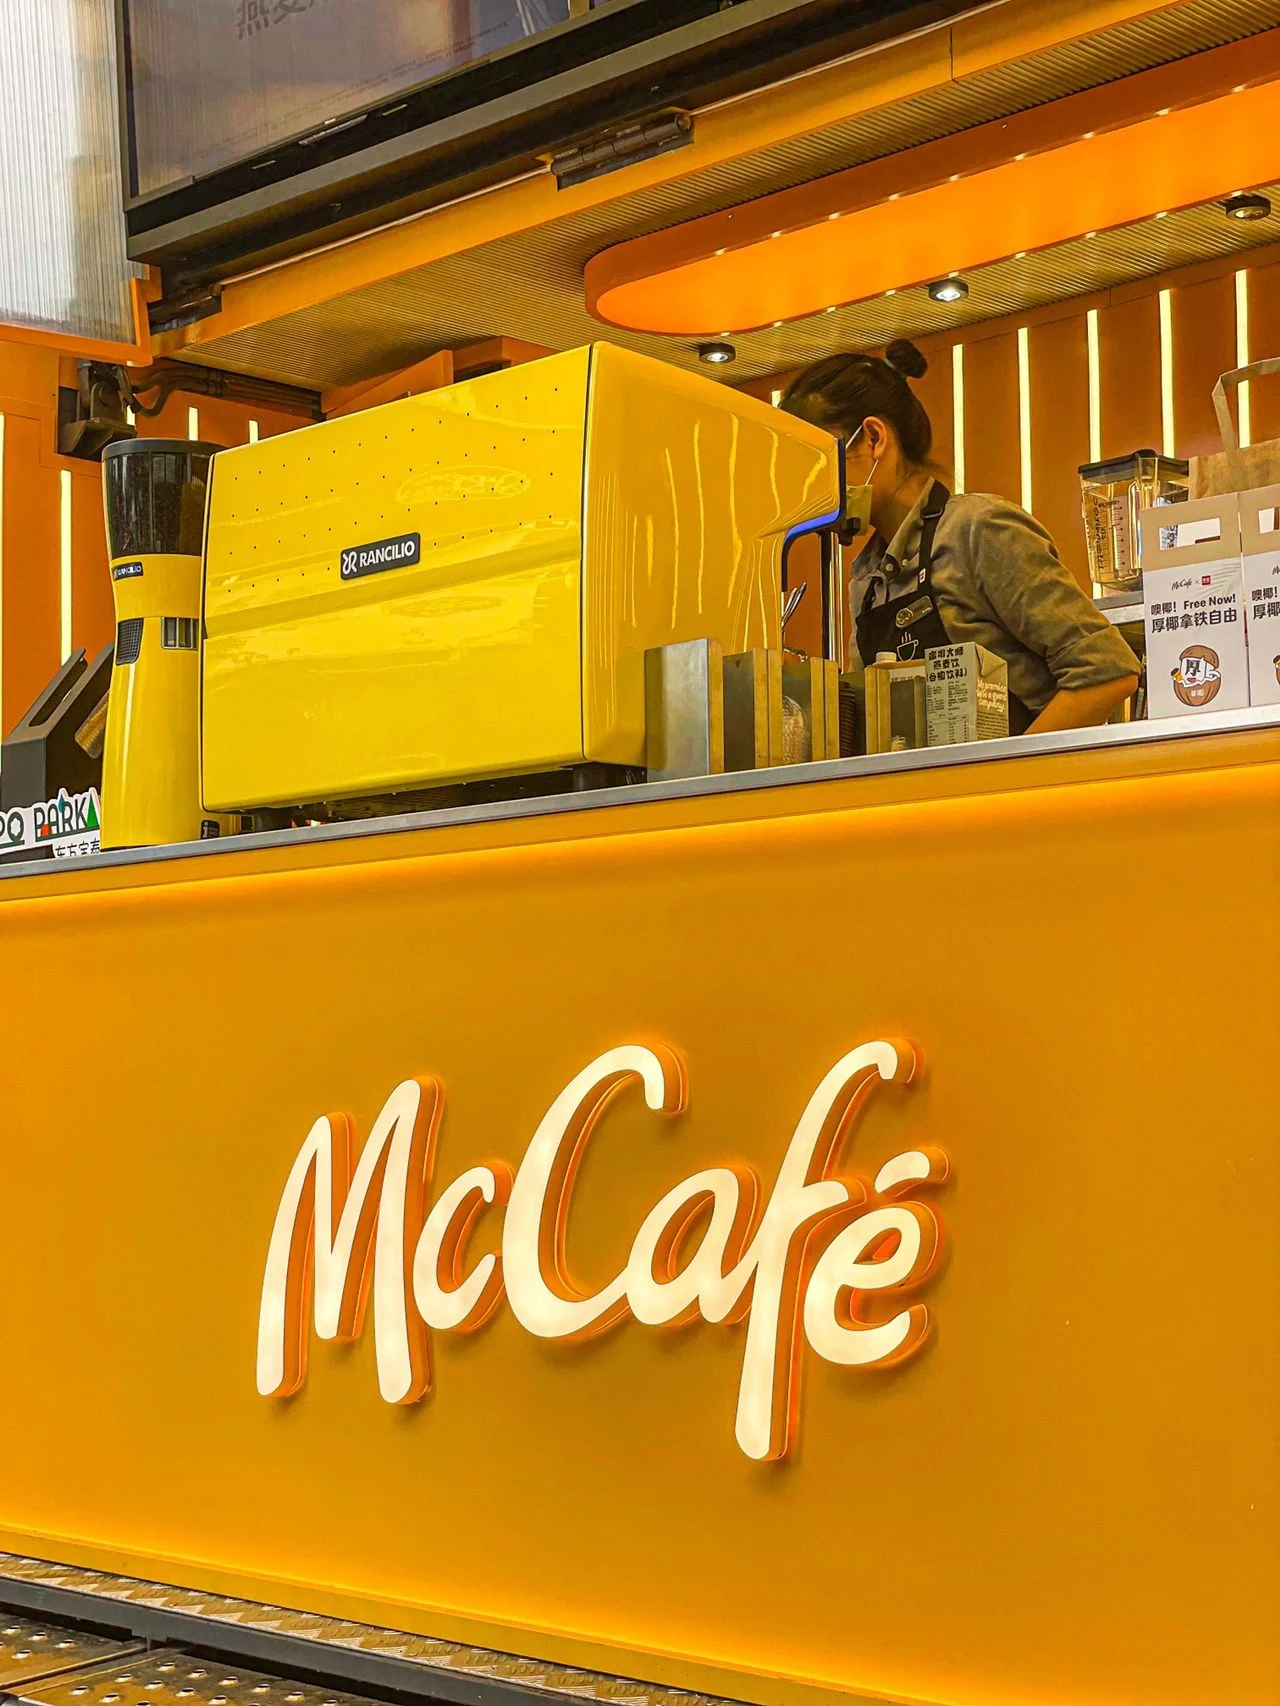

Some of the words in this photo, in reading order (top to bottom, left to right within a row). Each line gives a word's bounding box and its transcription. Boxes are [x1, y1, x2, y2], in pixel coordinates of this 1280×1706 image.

[359, 540, 416, 568] RANCILIO
[1183, 600, 1206, 610] Free
[1209, 593, 1236, 608] Now!
[1151, 607, 1237, 633] 厚椰拿铁自由
[1185, 659, 1201, 677] 厚
[256, 1038, 946, 1462] McCafé
